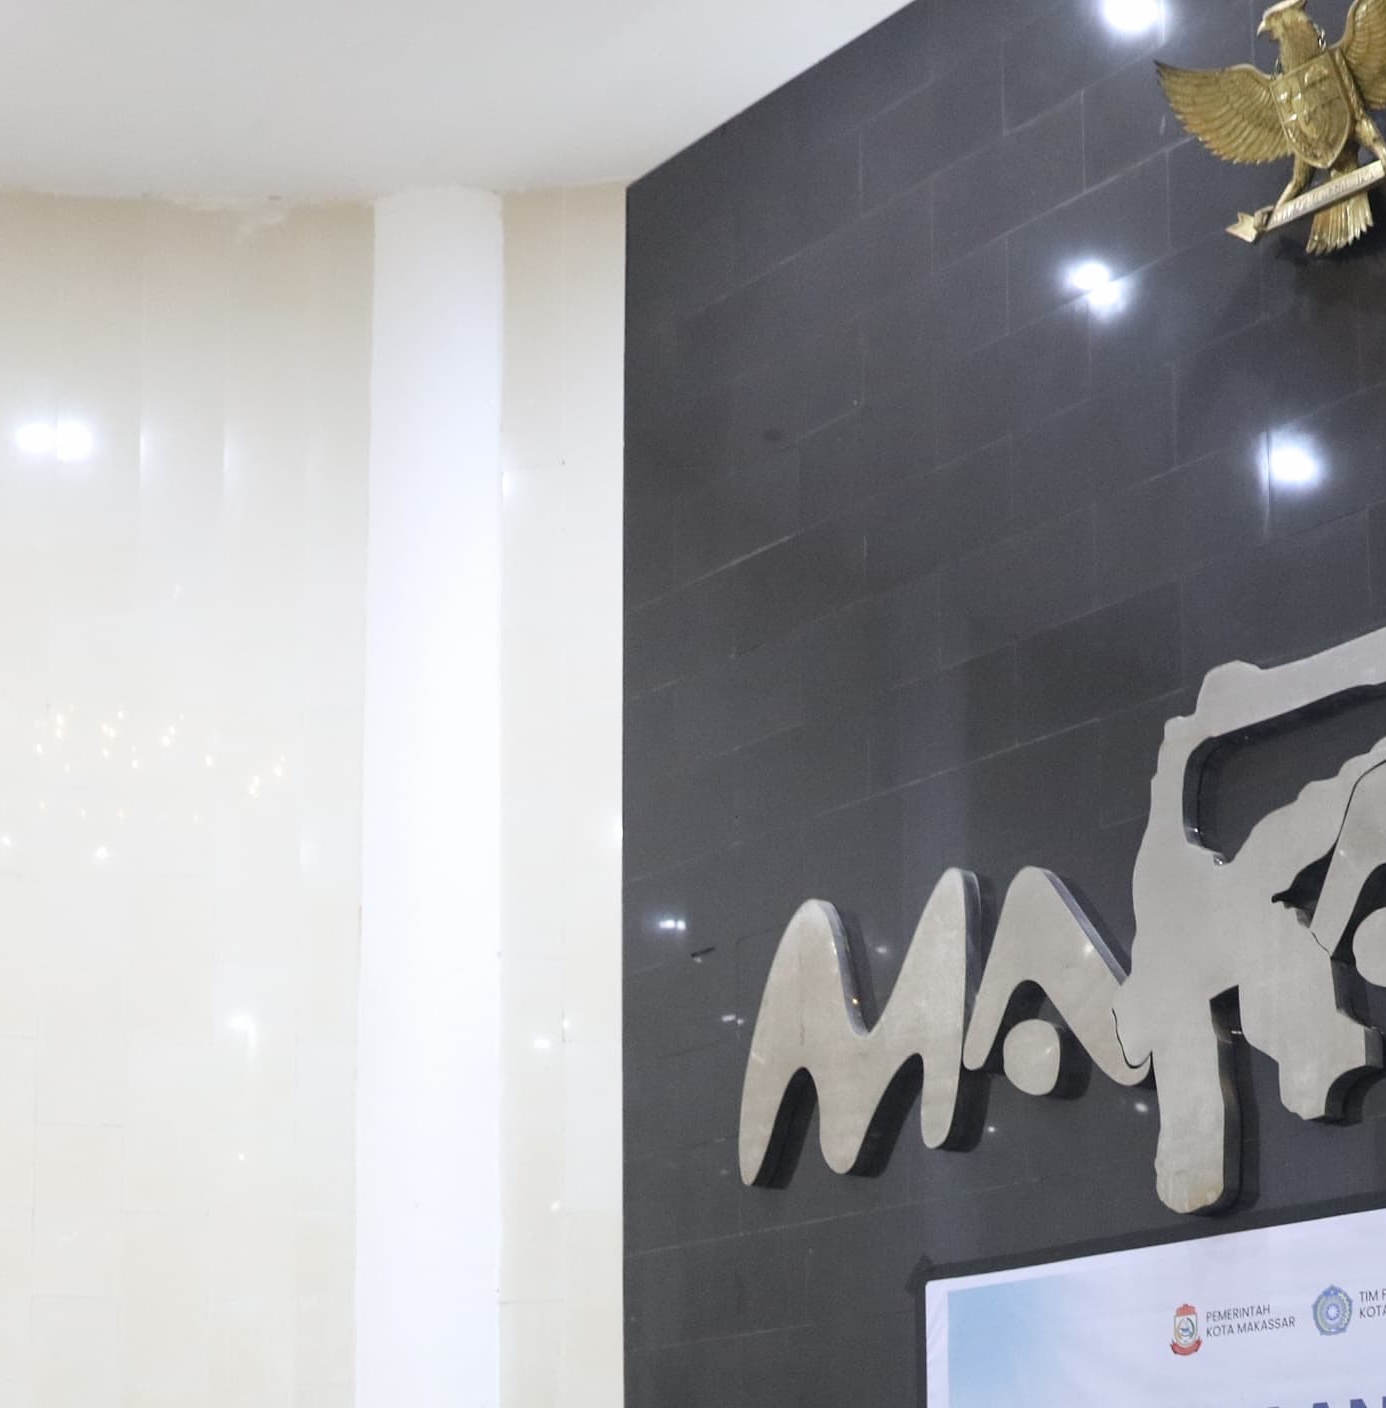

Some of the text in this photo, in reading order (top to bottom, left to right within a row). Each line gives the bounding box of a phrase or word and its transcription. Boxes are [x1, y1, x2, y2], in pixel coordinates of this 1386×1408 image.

[1359, 1290, 1379, 1303] TIM
[1206, 1304, 1271, 1322] PEMERINTAH
[1206, 1316, 1296, 1338] KOTA MAKASSAR
